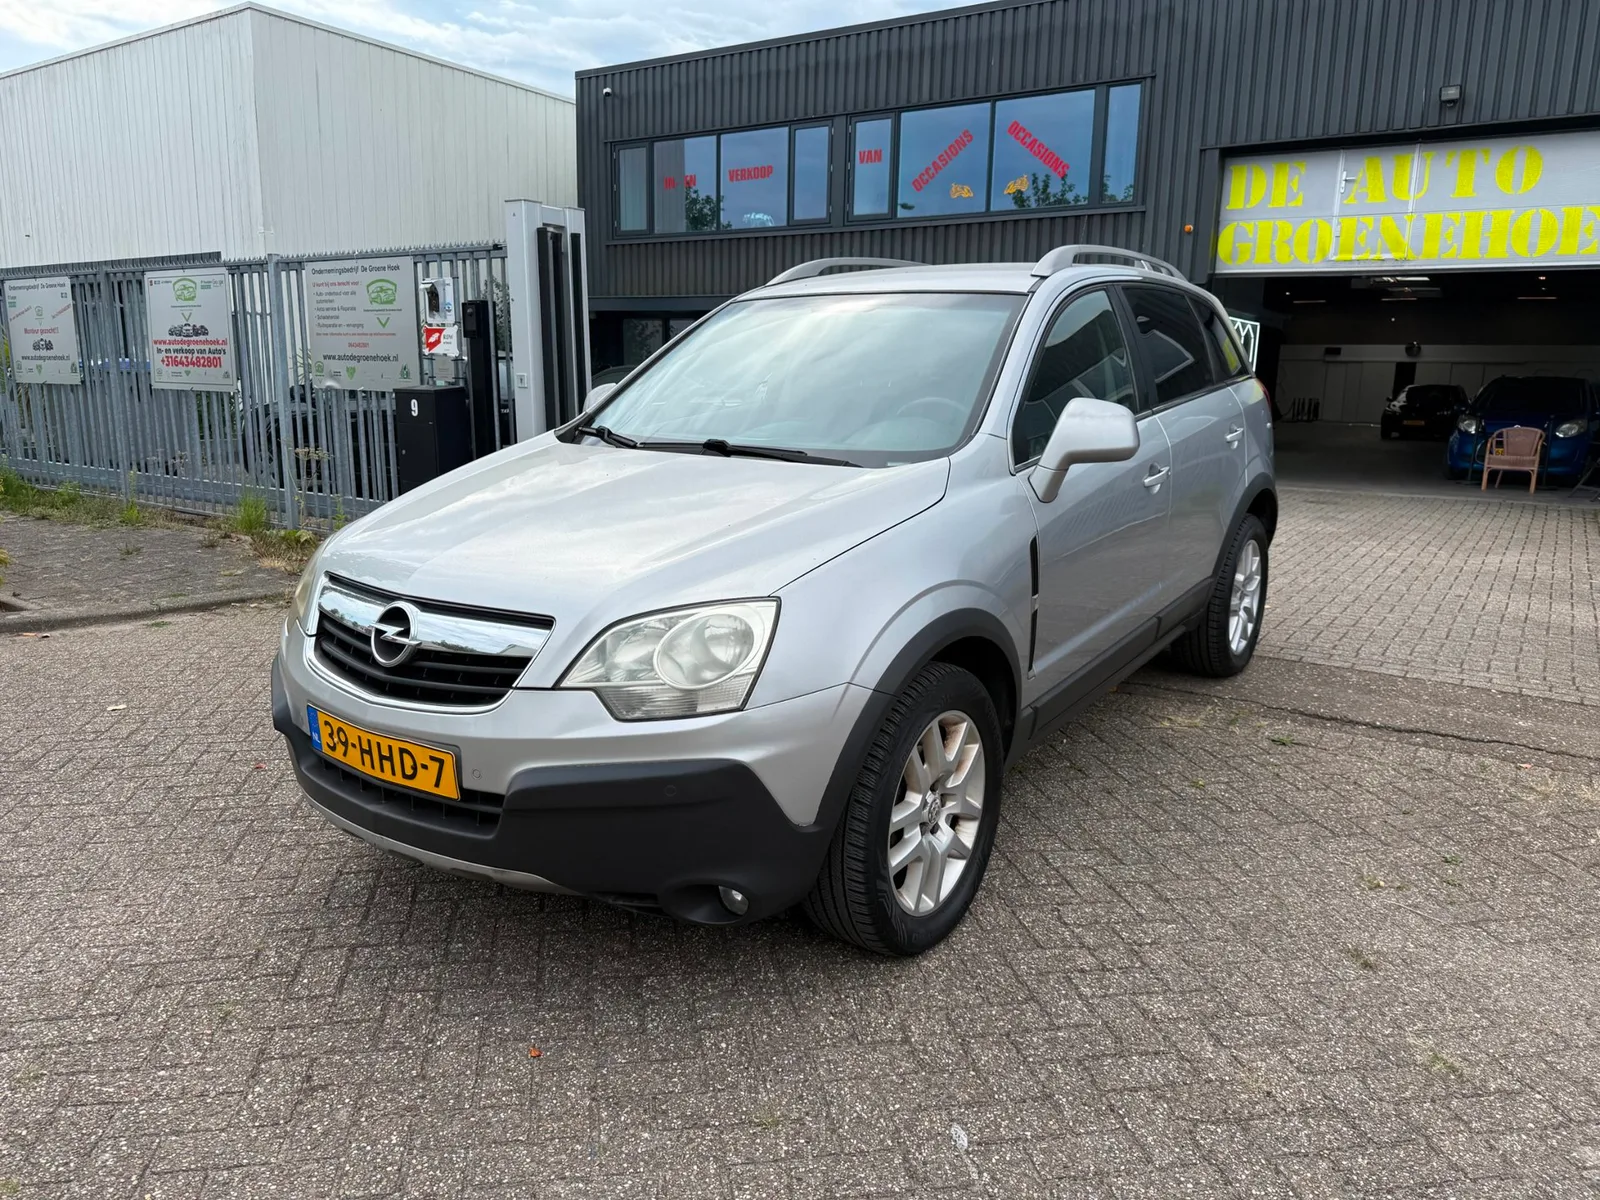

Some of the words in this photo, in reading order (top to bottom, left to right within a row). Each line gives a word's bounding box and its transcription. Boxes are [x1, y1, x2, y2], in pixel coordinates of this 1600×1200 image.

[1006, 119, 1071, 180] OCCASIONS
[728, 165, 774, 183] VERKOOP
[858, 148, 883, 165] VAN
[911, 128, 975, 193] OCCASIONS
[1226, 160, 1307, 210] DE
[1343, 145, 1544, 204] AUTO
[368, 264, 386, 272] Groene
[387, 263, 400, 271] Hoek
[152, 338, 228, 347] www.autodegroenehoek.nl
[173, 347, 195, 356] verkoop
[208, 347, 227, 355] Auto's
[322, 353, 399, 363] www.autodegroenehoek.nl
[160, 355, 222, 368] +31643482801
[410, 398, 419, 417] 9
[312, 733, 321, 744] NL
[323, 720, 445, 788] 39-HHD-7
